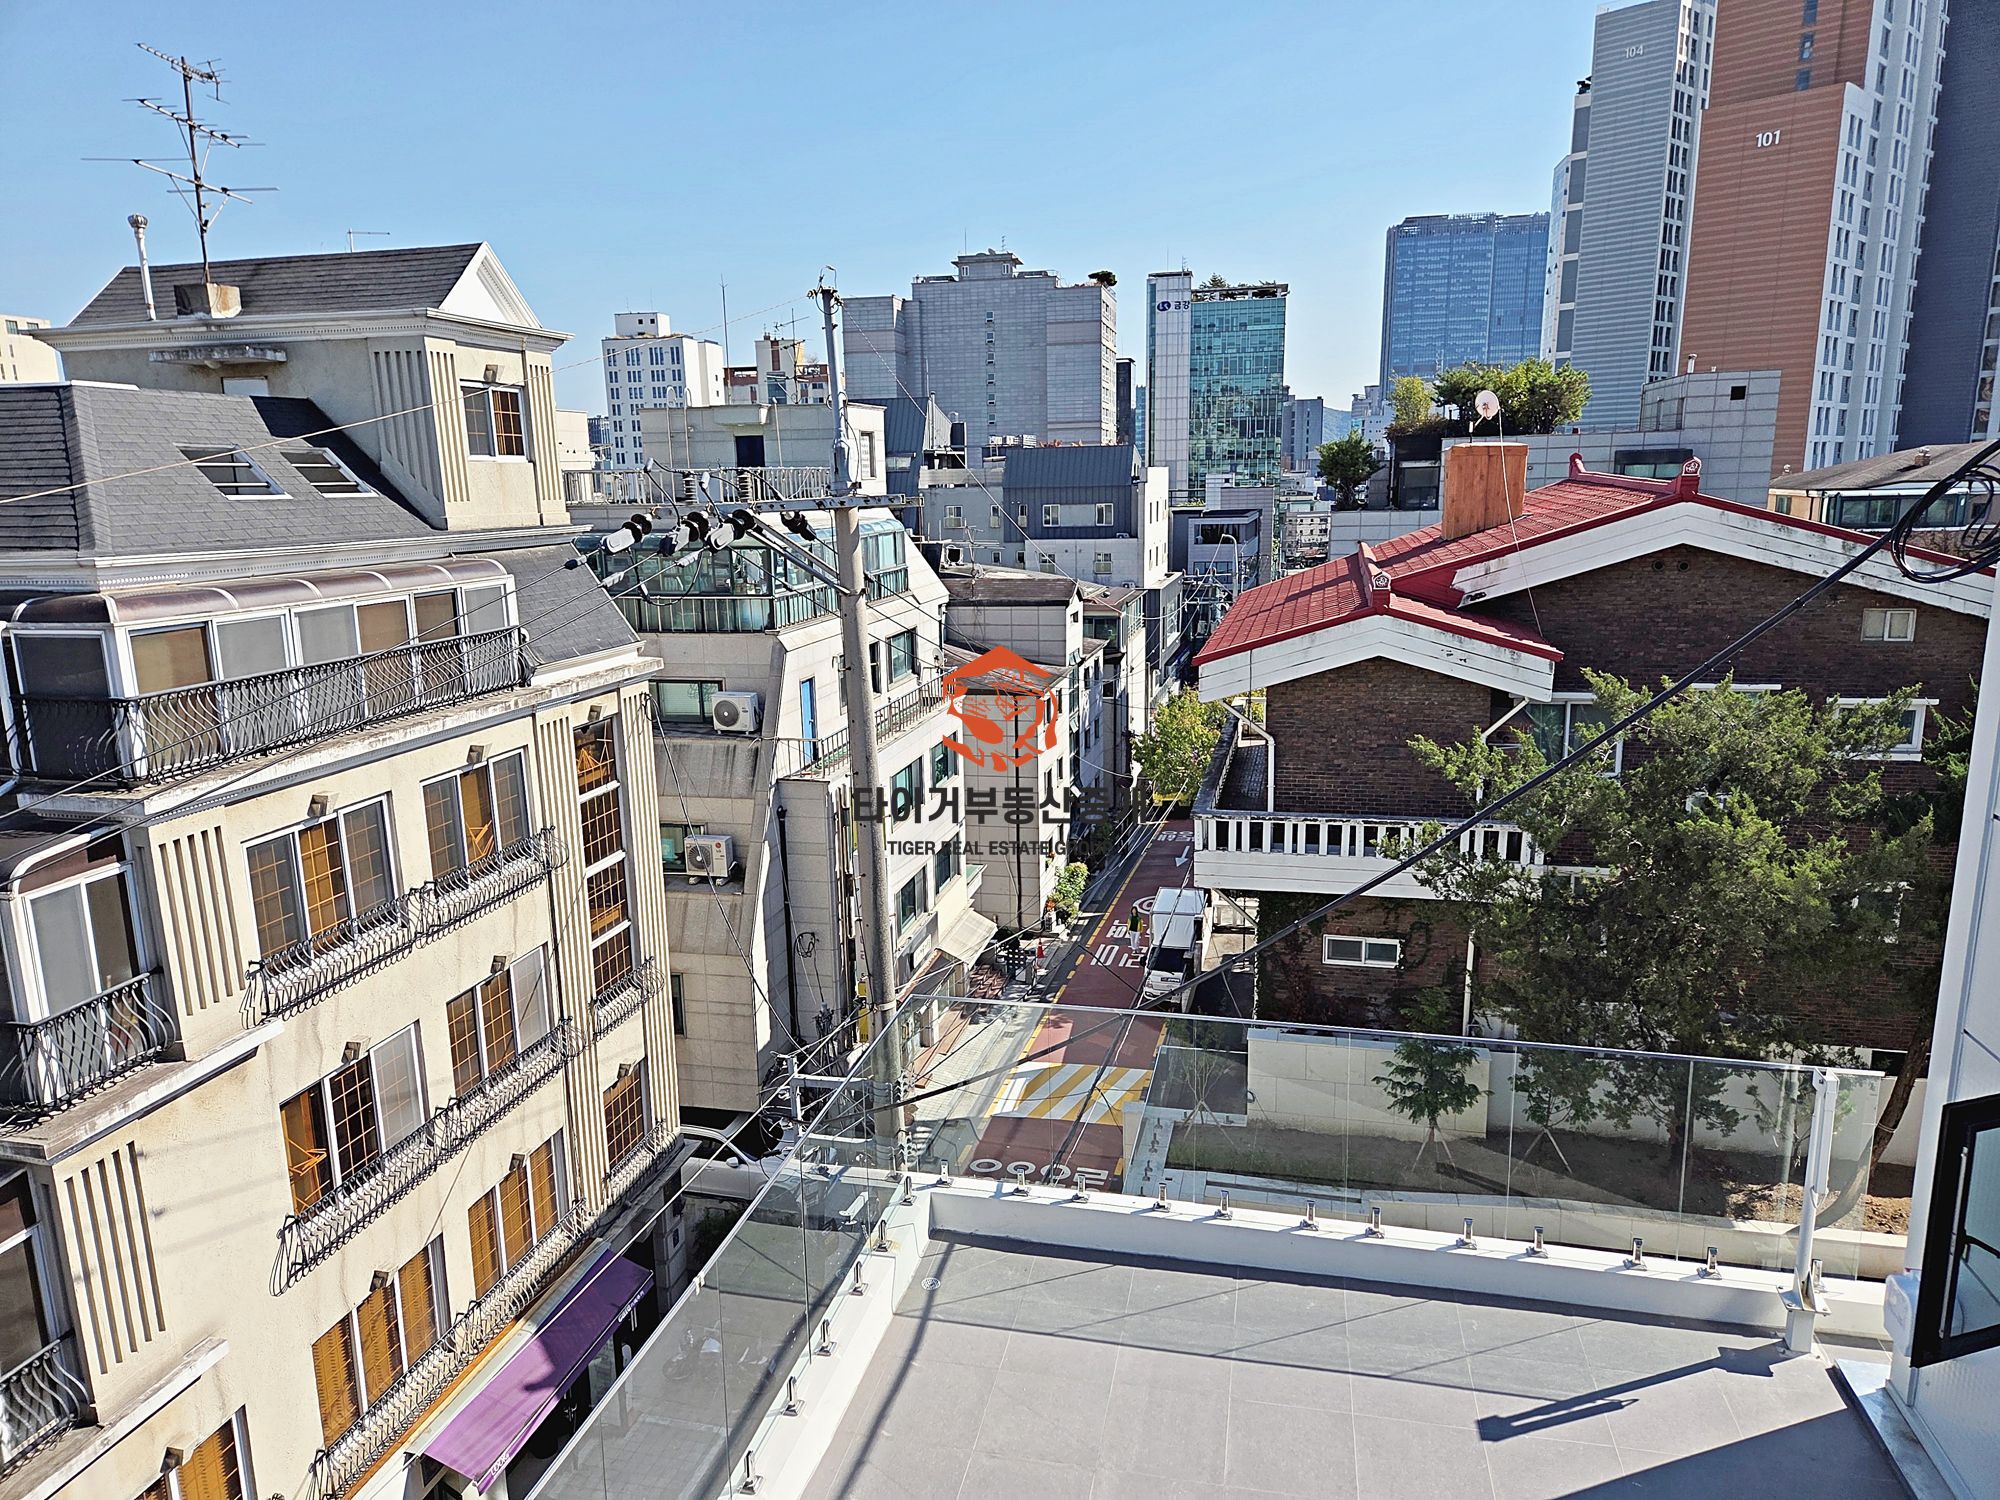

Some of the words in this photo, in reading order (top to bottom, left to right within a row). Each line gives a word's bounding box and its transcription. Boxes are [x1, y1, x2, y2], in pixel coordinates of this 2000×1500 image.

[1624, 44, 1644, 59] 104
[1755, 129, 1781, 148] 101
[1174, 300, 1190, 310] 금강
